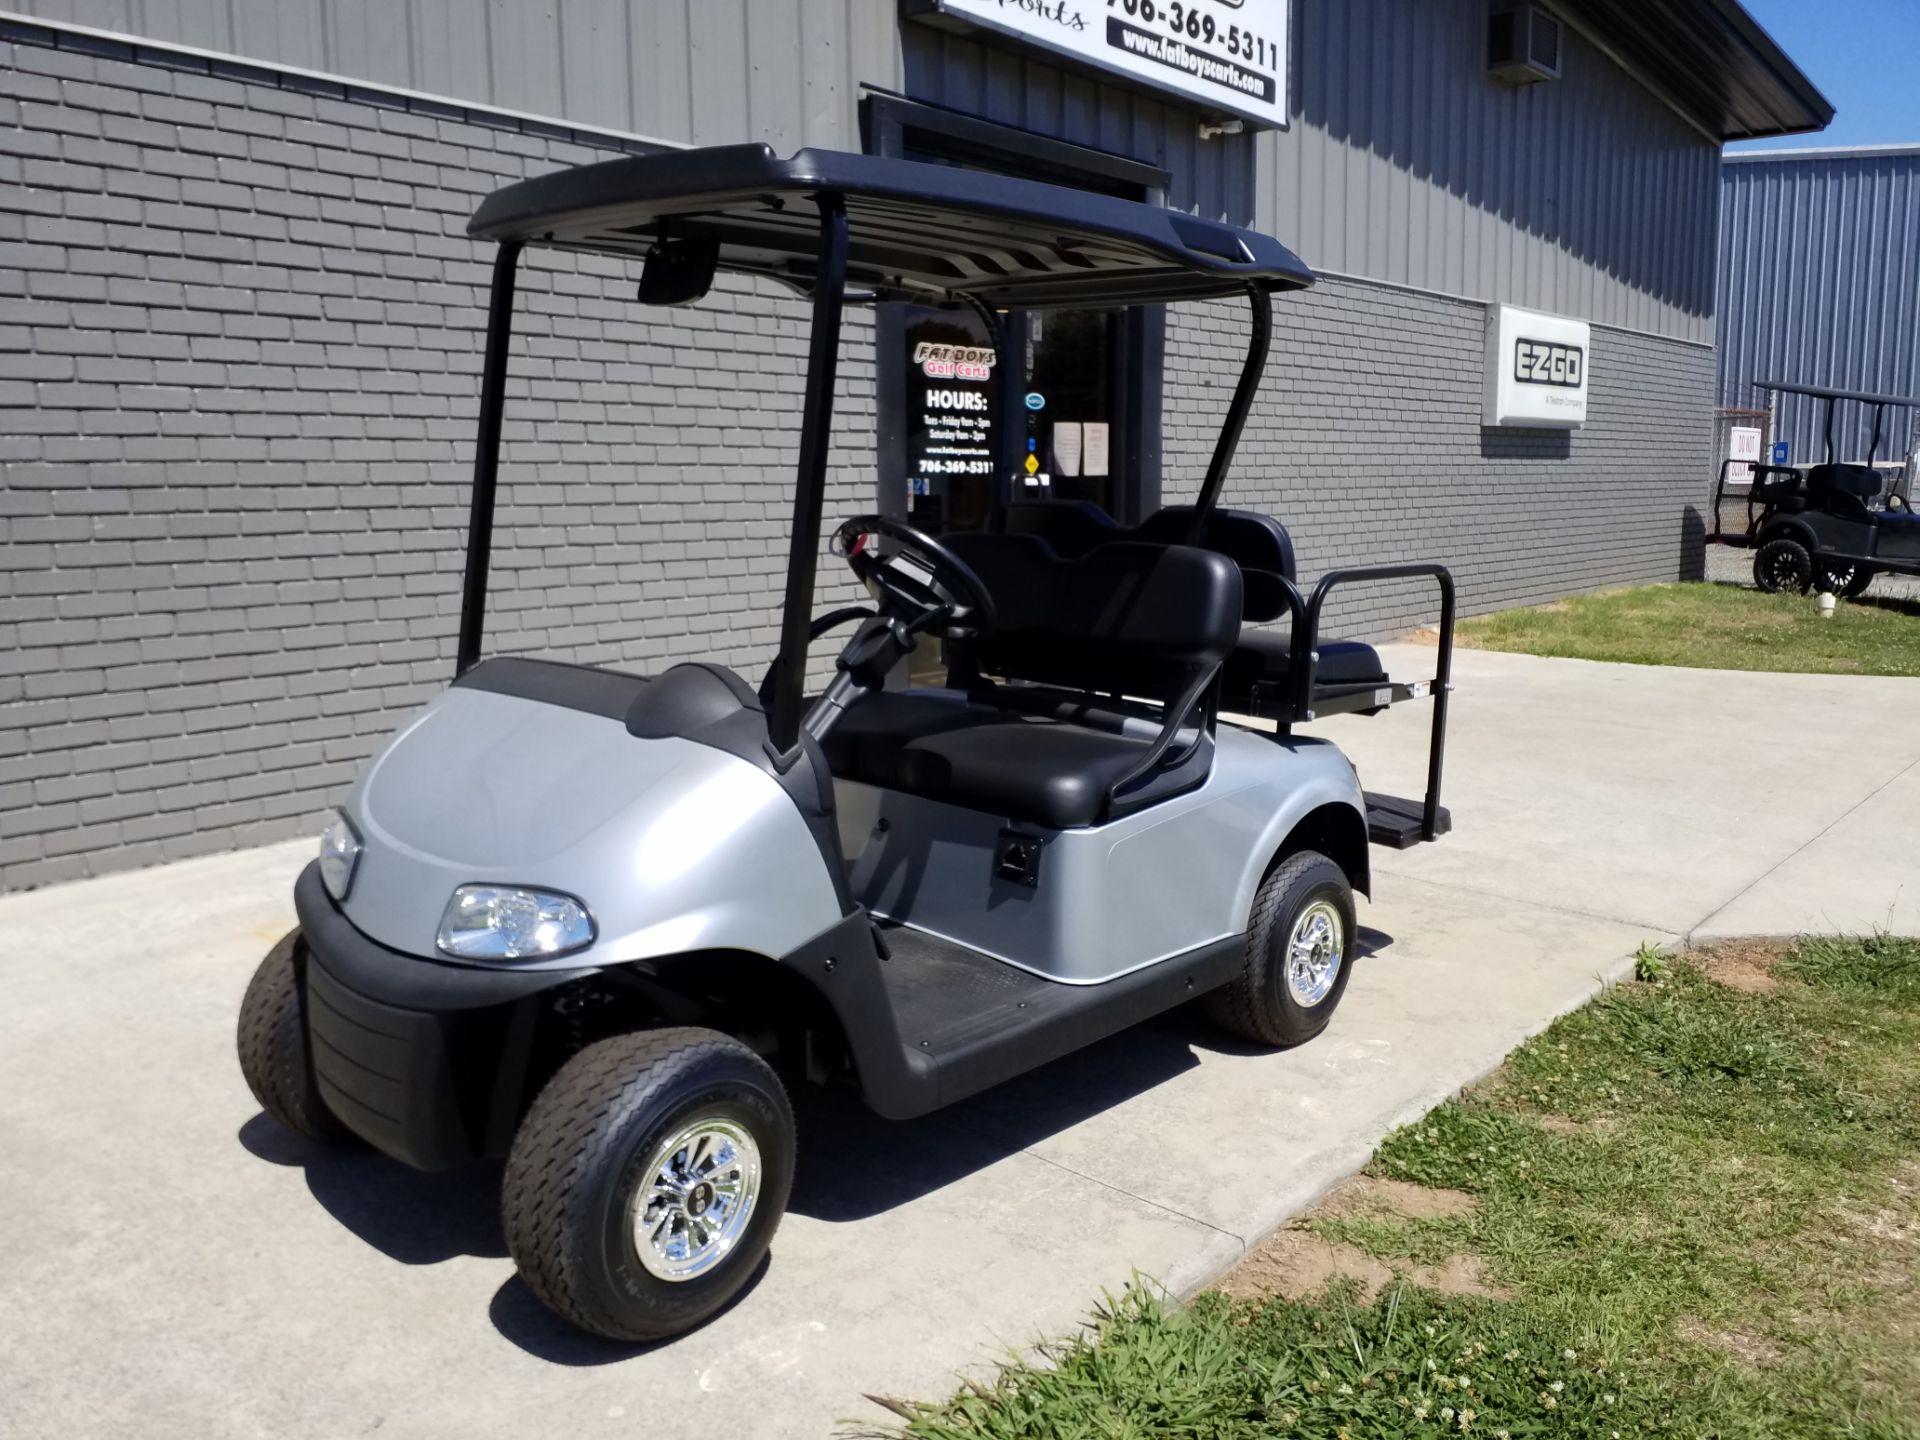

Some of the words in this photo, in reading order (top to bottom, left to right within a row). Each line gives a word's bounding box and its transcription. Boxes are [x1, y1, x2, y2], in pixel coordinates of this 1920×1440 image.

[1107, 0, 1277, 71] 06-369-5311
[1122, 29, 1265, 97] www.fatboyscarts.com
[918, 346, 951, 360] FAT
[954, 349, 994, 363] BOYS
[1516, 341, 1581, 385] EZGO
[927, 361, 955, 374] Golf
[956, 363, 987, 377] Carts
[926, 389, 988, 411] HOURS:
[942, 415, 961, 428] Friday
[929, 428, 955, 441] Saturday
